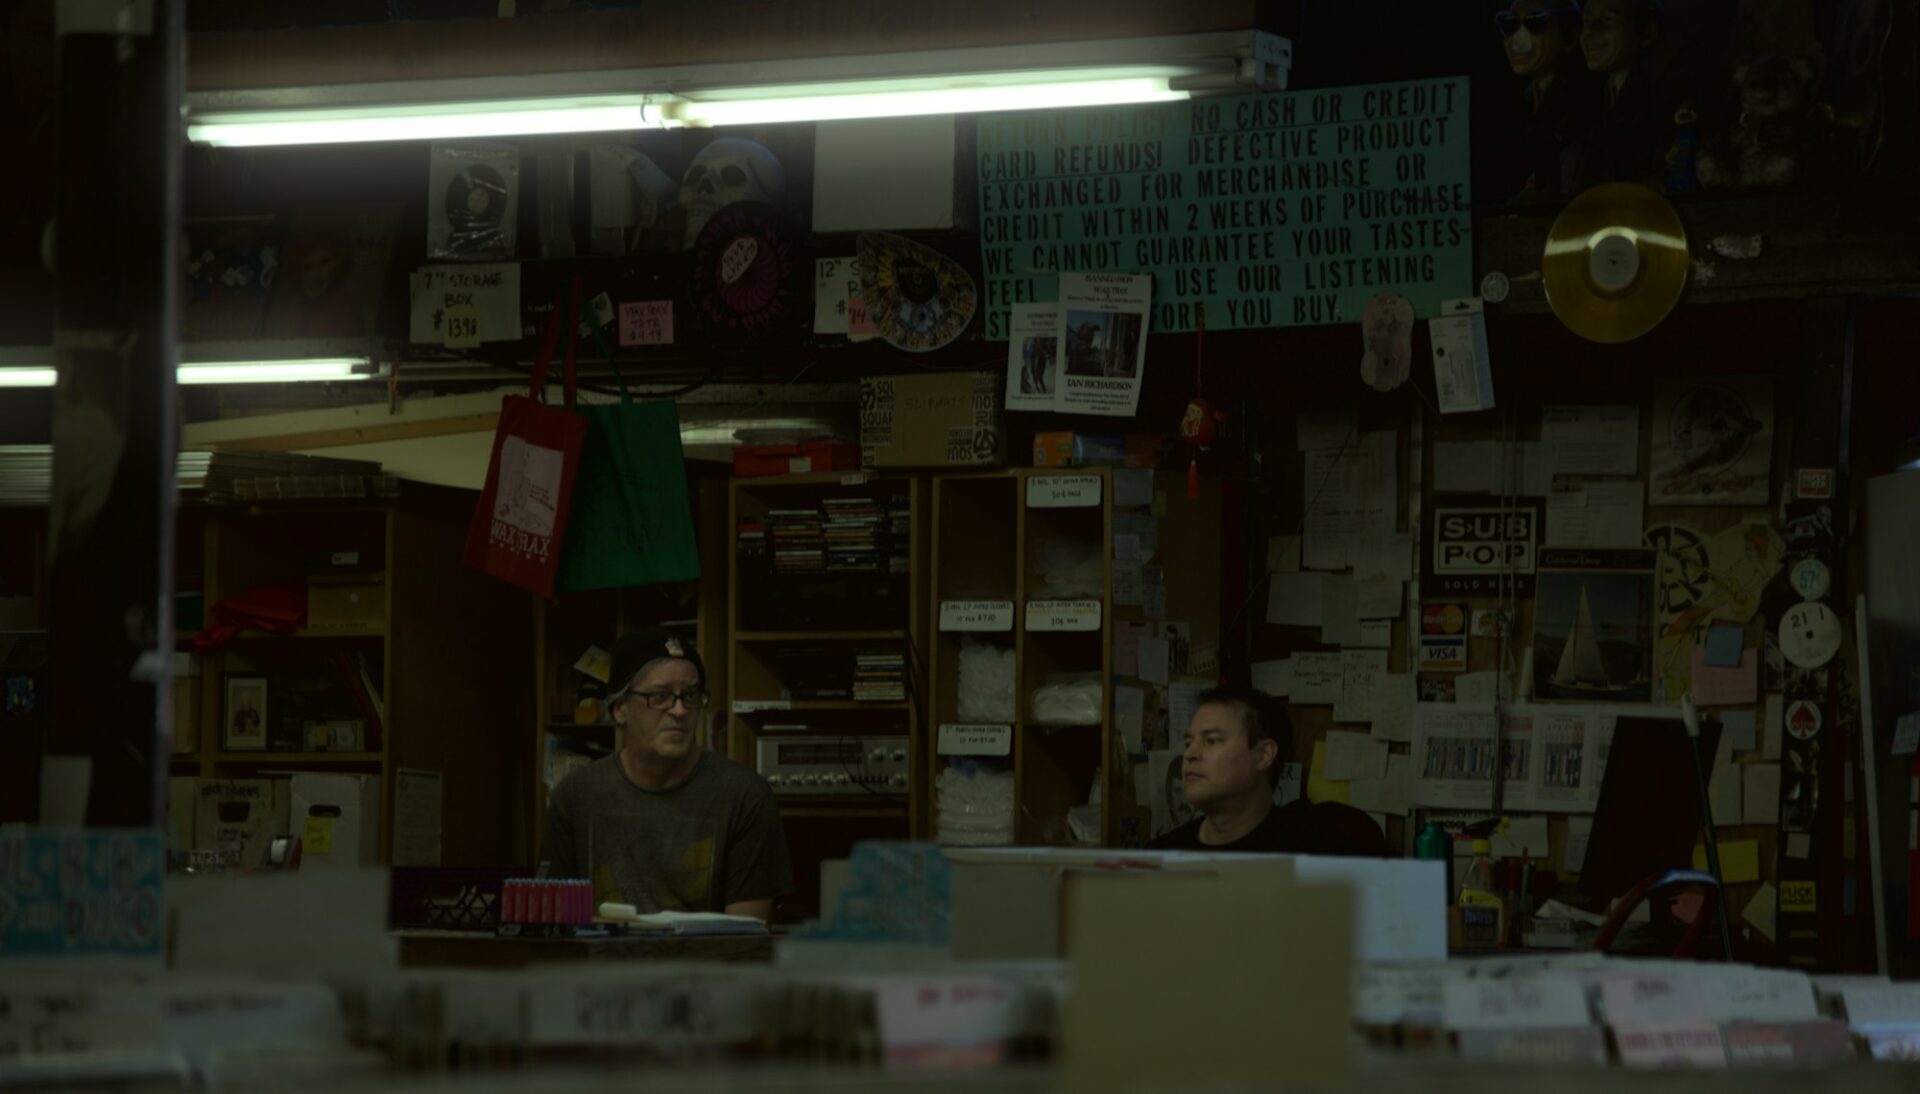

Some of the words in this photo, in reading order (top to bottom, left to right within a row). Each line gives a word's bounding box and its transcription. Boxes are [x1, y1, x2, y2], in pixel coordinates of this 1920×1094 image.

[1086, 107, 1168, 140] POLICY
[1191, 104, 1221, 132] NO
[1236, 96, 1297, 129] CASH
[1311, 93, 1343, 123] OR
[1363, 83, 1457, 119] CREDIT
[980, 150, 1036, 180] CARD
[1054, 140, 1162, 174] REFUNDS!
[1188, 128, 1318, 166] DEFECTIVE
[1337, 116, 1449, 154] PRODUCT
[982, 175, 1122, 212] EXCHANGED
[1141, 172, 1183, 203] FOR
[1197, 158, 1370, 198] MERCHANDISE
[1395, 153, 1427, 182] OR
[983, 212, 1064, 243] CREDIT
[1081, 204, 1170, 238] WITHIN
[1187, 203, 1198, 232] 2
[1209, 197, 1289, 231] WEEKS
[1300, 194, 1327, 224] OF
[985, 247, 1015, 275] WE
[1032, 240, 1122, 272] CANNOT
[1136, 231, 1276, 267] GUARANTEE
[1292, 226, 1352, 258] YOUR
[819, 260, 841, 279] 12"
[988, 278, 1039, 307] FEEL
[1175, 267, 1218, 297] USE
[1237, 264, 1282, 294] OUR
[1304, 254, 1436, 291] LISTENING
[444, 293, 473, 307] BOX
[1226, 297, 1273, 328] YOU
[1293, 294, 1343, 324] BUY.
[1066, 378, 1084, 388] IAN
[1084, 379, 1133, 391] RICHARDSON
[1444, 545, 1526, 566] POP
[1444, 580, 1481, 590] SOLD
[1428, 646, 1457, 661] VISA
